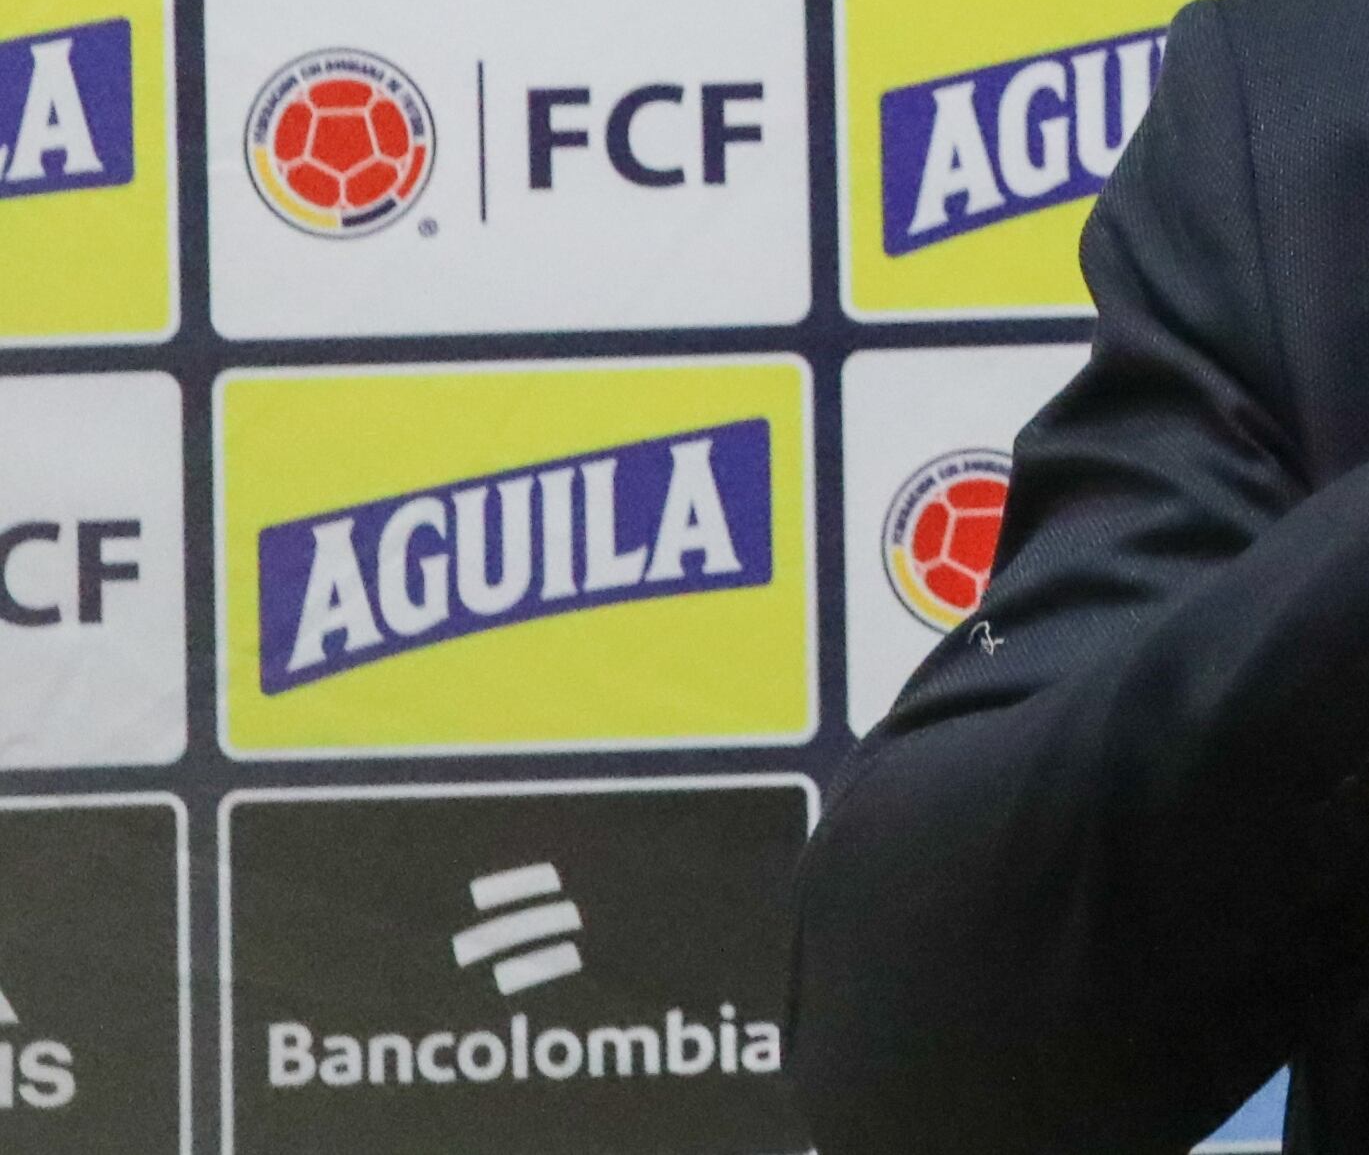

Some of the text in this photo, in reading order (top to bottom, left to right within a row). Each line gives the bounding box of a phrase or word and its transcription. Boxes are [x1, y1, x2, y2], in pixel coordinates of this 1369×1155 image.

[527, 82, 764, 190] FCF
[907, 36, 1167, 236] AGU
[0, 519, 140, 626] CF
[285, 438, 742, 673] AGUILA
[268, 1003, 781, 1087] Bancolombia
